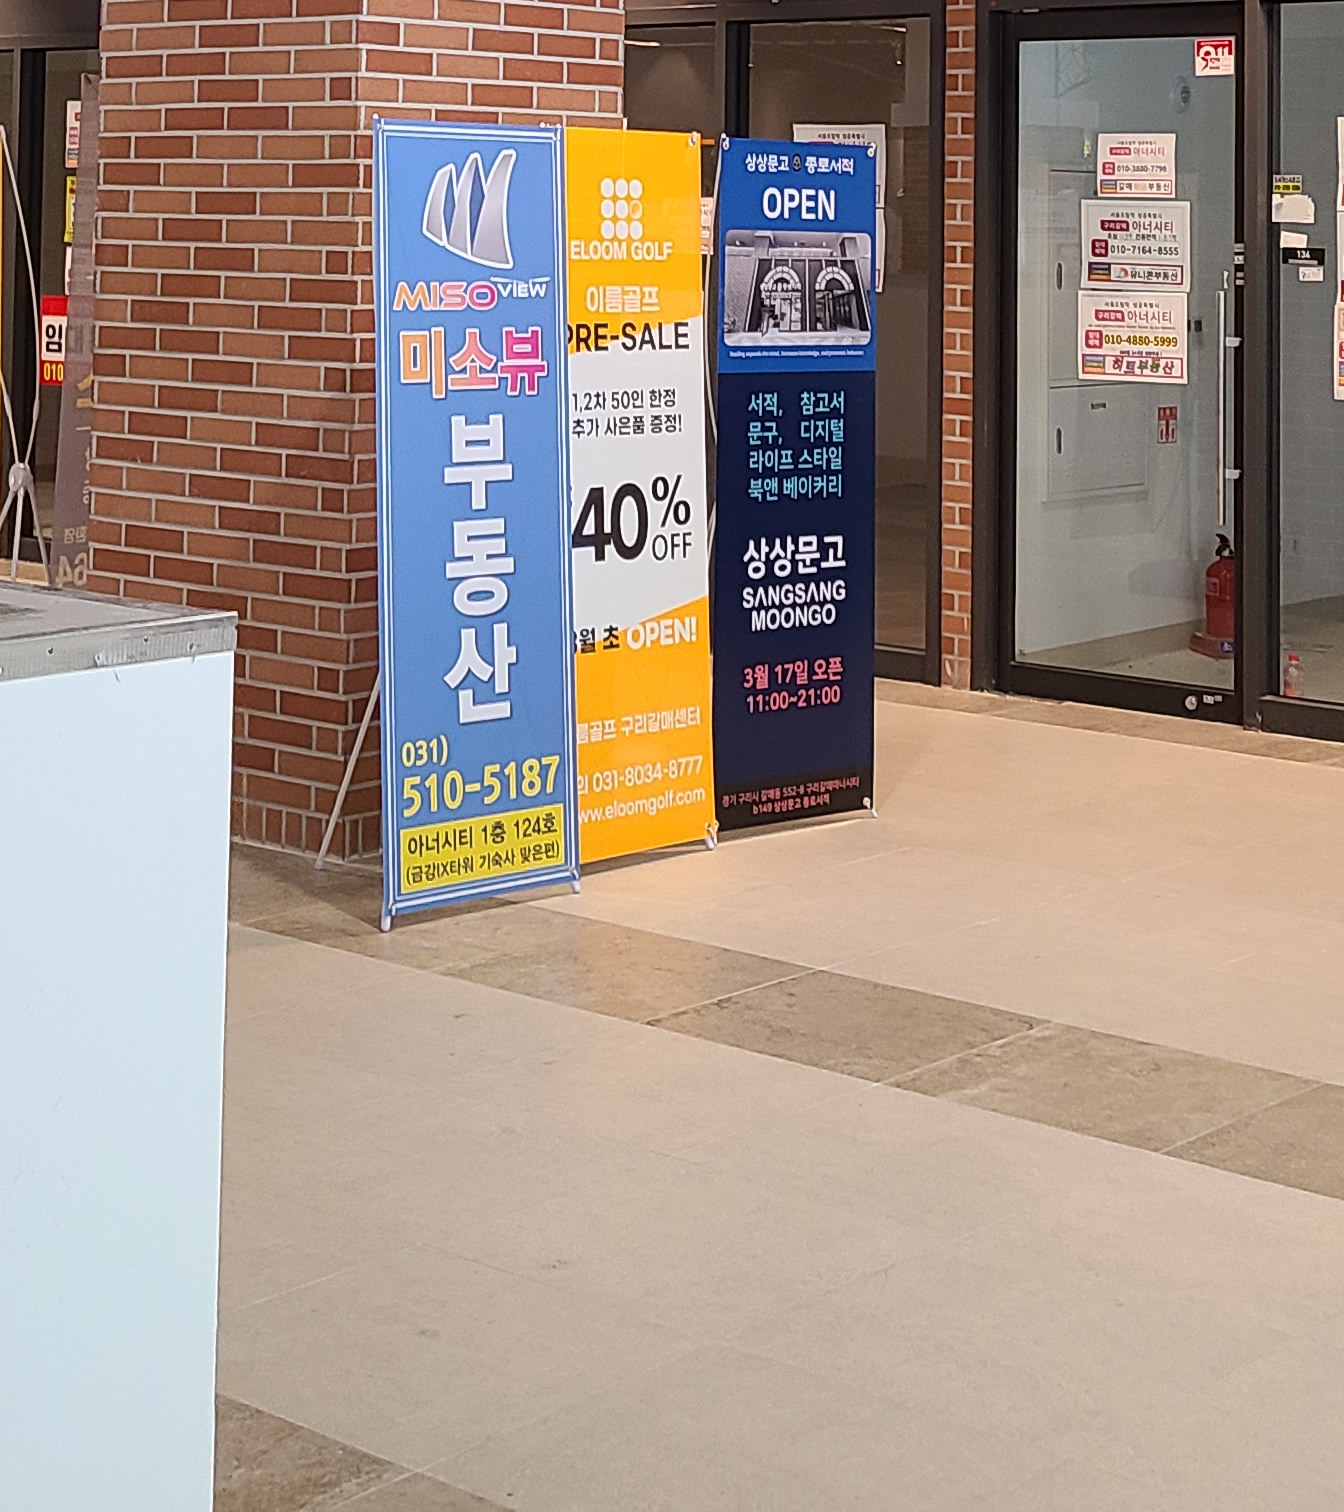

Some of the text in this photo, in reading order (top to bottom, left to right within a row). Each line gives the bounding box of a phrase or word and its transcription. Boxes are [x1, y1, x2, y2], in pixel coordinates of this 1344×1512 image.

[744, 153, 854, 175] 상상문고 종로서적
[761, 187, 835, 221] OPEN
[1131, 221, 1173, 233] 아너시티
[569, 241, 673, 261] ELOOM GOLF
[1109, 245, 1179, 255] 010-7164-8555
[392, 279, 547, 310] MISO VIEW
[585, 285, 660, 313] 이룸골프
[1127, 311, 1172, 324] 아너시티
[399, 326, 547, 399] 미소뷰
[571, 388, 675, 413] 1,2차 50인 한정
[747, 391, 844, 417] 서적, 참고서
[571, 414, 682, 438] 추가 사은품 증정!
[747, 418, 844, 445] 문구, 디지털
[748, 446, 842, 473] 라이프 스타일
[747, 474, 842, 502] 북앤 베이커리
[651, 532, 692, 561] OFF
[742, 535, 846, 580] 상상문고
[442, 414, 517, 724] 부동산
[741, 580, 846, 608] SANGSANG
[750, 604, 836, 632] MOONGO
[602, 625, 620, 650] 초
[626, 616, 696, 650] OPEN!
[743, 656, 843, 690] 3월 17일 오픈
[745, 685, 841, 714] 11:00~21:00
[576, 706, 700, 744] 룸골프 구리갈매센터
[401, 735, 448, 767] 031)
[402, 755, 559, 818] 510-5187
[577, 755, 703, 794] 의 031-8034-8777
[578, 788, 705, 824] ww.eloomgolf.com
[407, 813, 557, 857] 아너시티 1층 124호
[478, 848, 515, 870] 기숙사
[519, 840, 559, 864] 맞은편)
